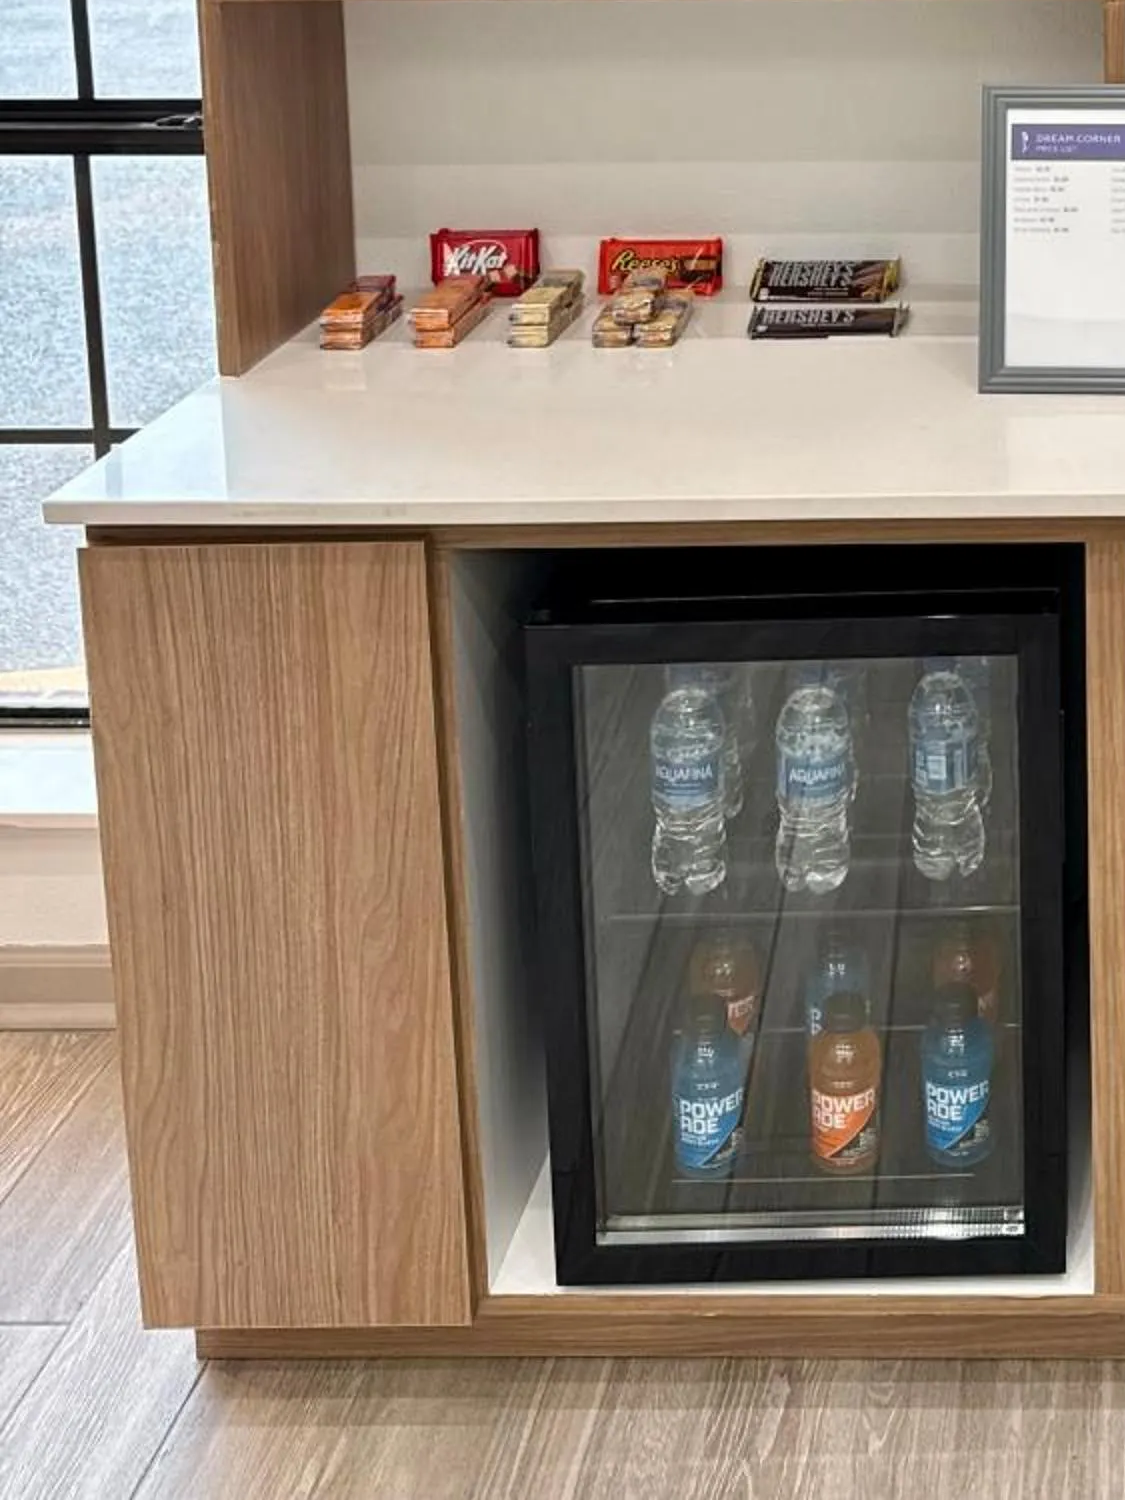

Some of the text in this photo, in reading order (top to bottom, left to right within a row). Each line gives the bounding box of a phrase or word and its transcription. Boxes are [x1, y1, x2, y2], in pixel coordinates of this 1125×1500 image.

[1036, 133, 1121, 144] DREAM CORNER
[762, 309, 855, 325] HERSHEY'S
